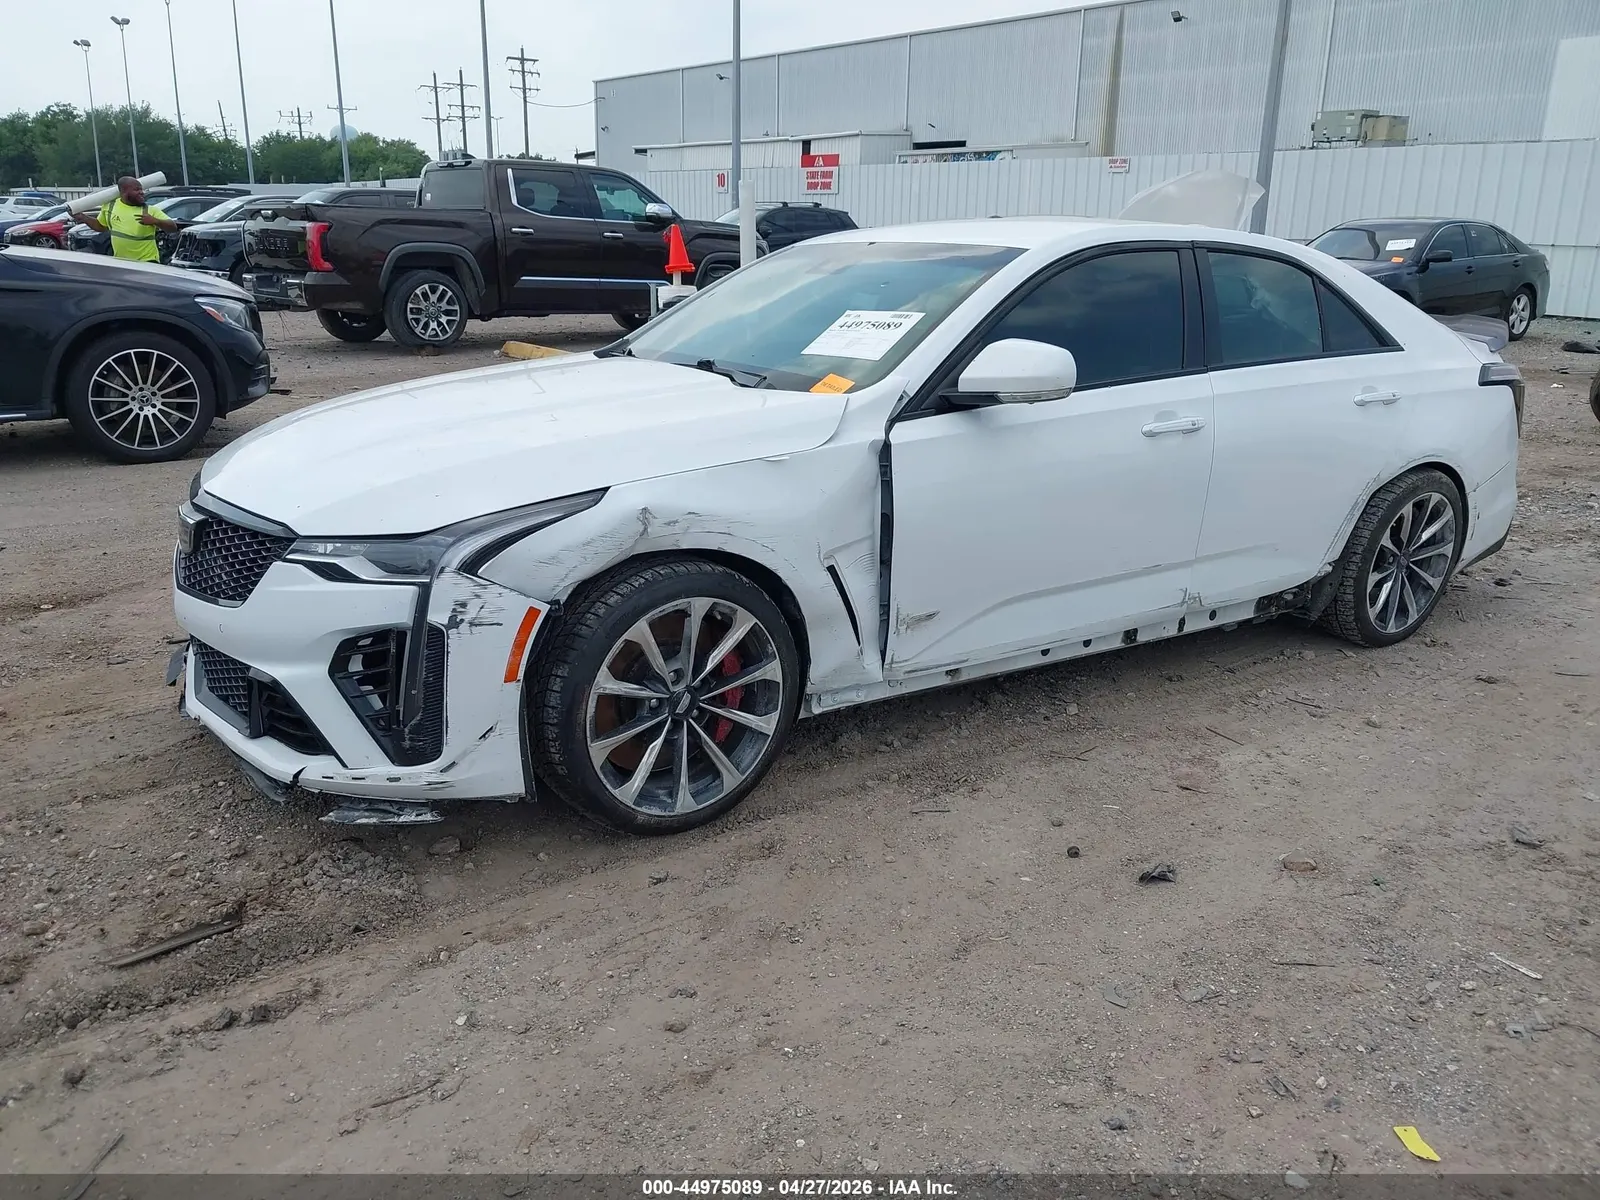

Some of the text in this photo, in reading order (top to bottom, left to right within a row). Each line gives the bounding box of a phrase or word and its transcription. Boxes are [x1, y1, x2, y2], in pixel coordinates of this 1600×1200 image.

[716, 172, 726, 188] 10
[806, 170, 833, 180] STATE FARM
[807, 181, 832, 191] DROP ZONE
[838, 320, 903, 330] 44975089
